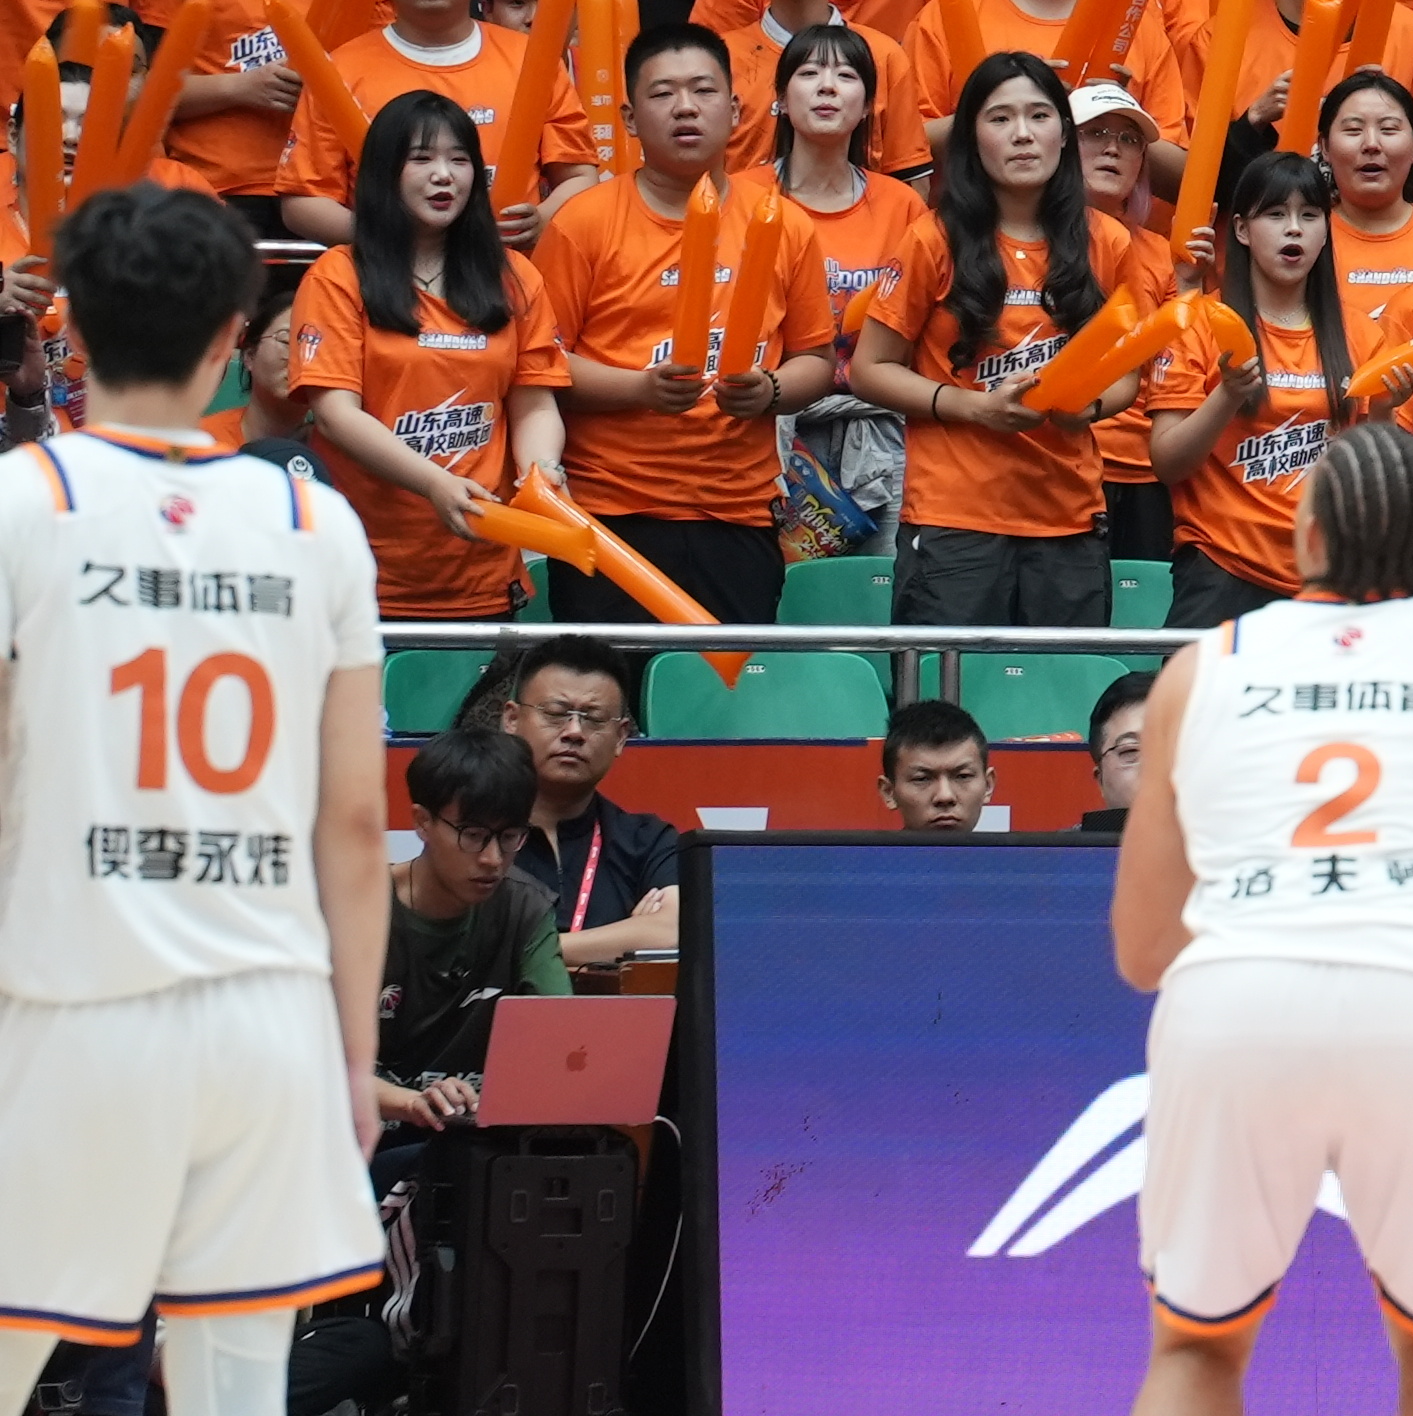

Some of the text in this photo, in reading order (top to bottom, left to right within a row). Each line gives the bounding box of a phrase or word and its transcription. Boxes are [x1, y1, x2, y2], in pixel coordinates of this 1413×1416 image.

[396, 411, 481, 437] 山东高速
[81, 561, 293, 616] 久事体育
[111, 648, 276, 796] 10
[1292, 743, 1382, 847] 2
